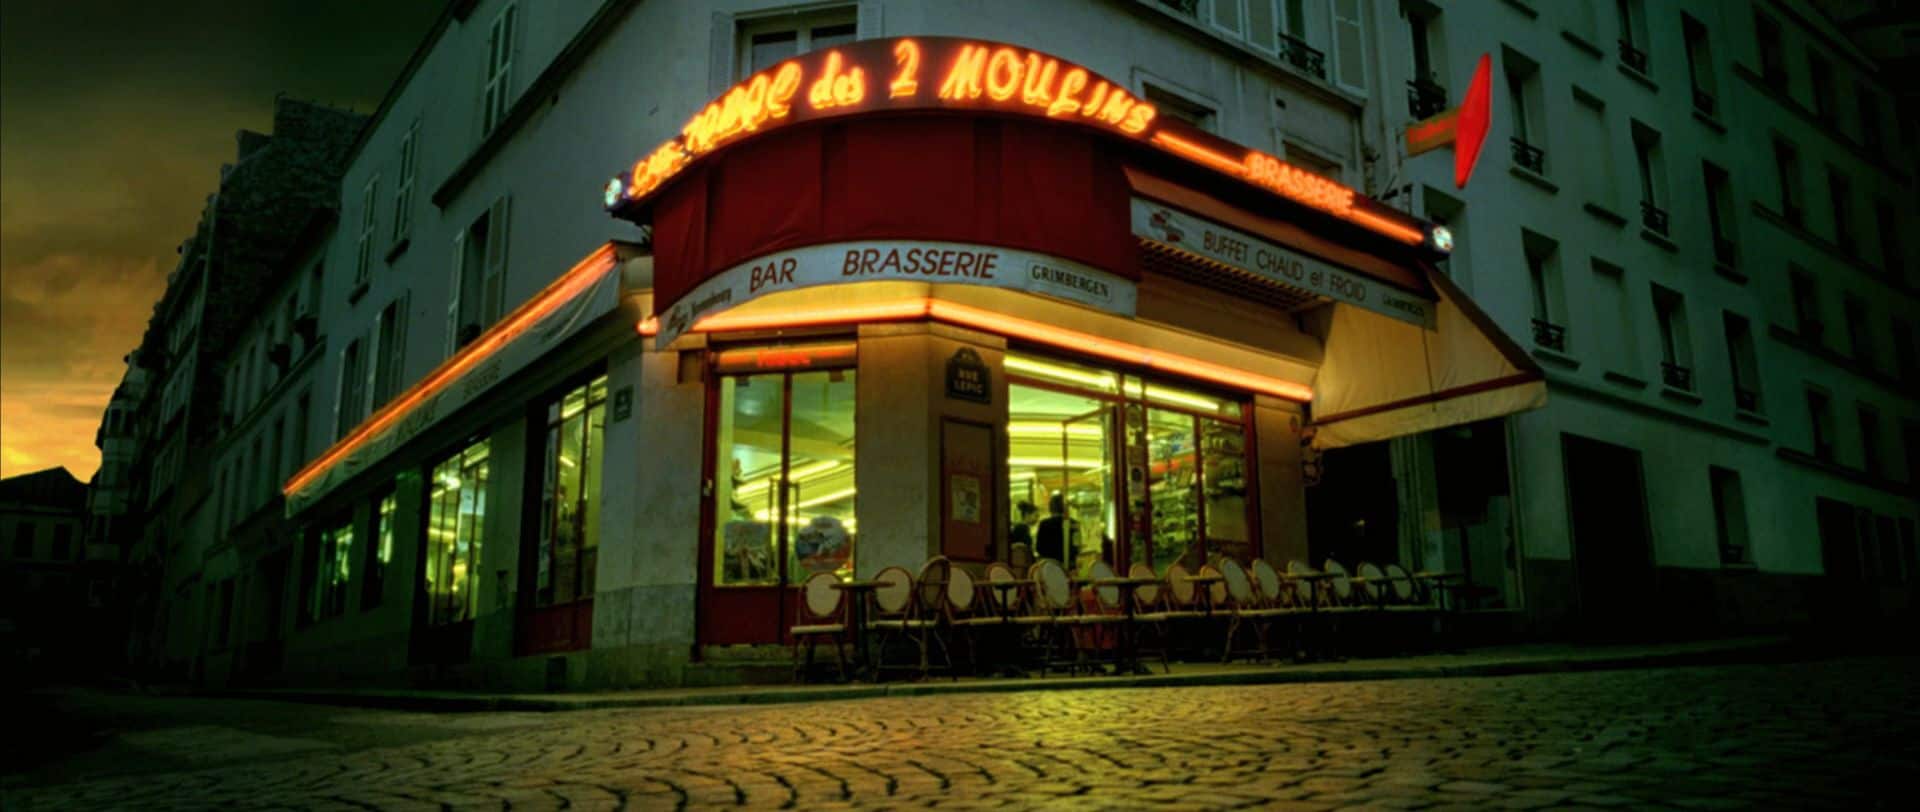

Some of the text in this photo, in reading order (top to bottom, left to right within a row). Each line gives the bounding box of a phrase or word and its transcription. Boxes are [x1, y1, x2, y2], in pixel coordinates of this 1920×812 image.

[808, 50, 865, 109] des
[889, 39, 920, 98] 2
[939, 43, 1159, 135] MOULINS
[1244, 150, 1356, 215] BRASSERIE
[749, 248, 999, 292] BAR BRASSERIE
[1031, 264, 1109, 297] GRIMBERGEN
[1203, 230, 1367, 301] BUFFET CHAUD et FROID
[953, 379, 984, 395] LEPIC
